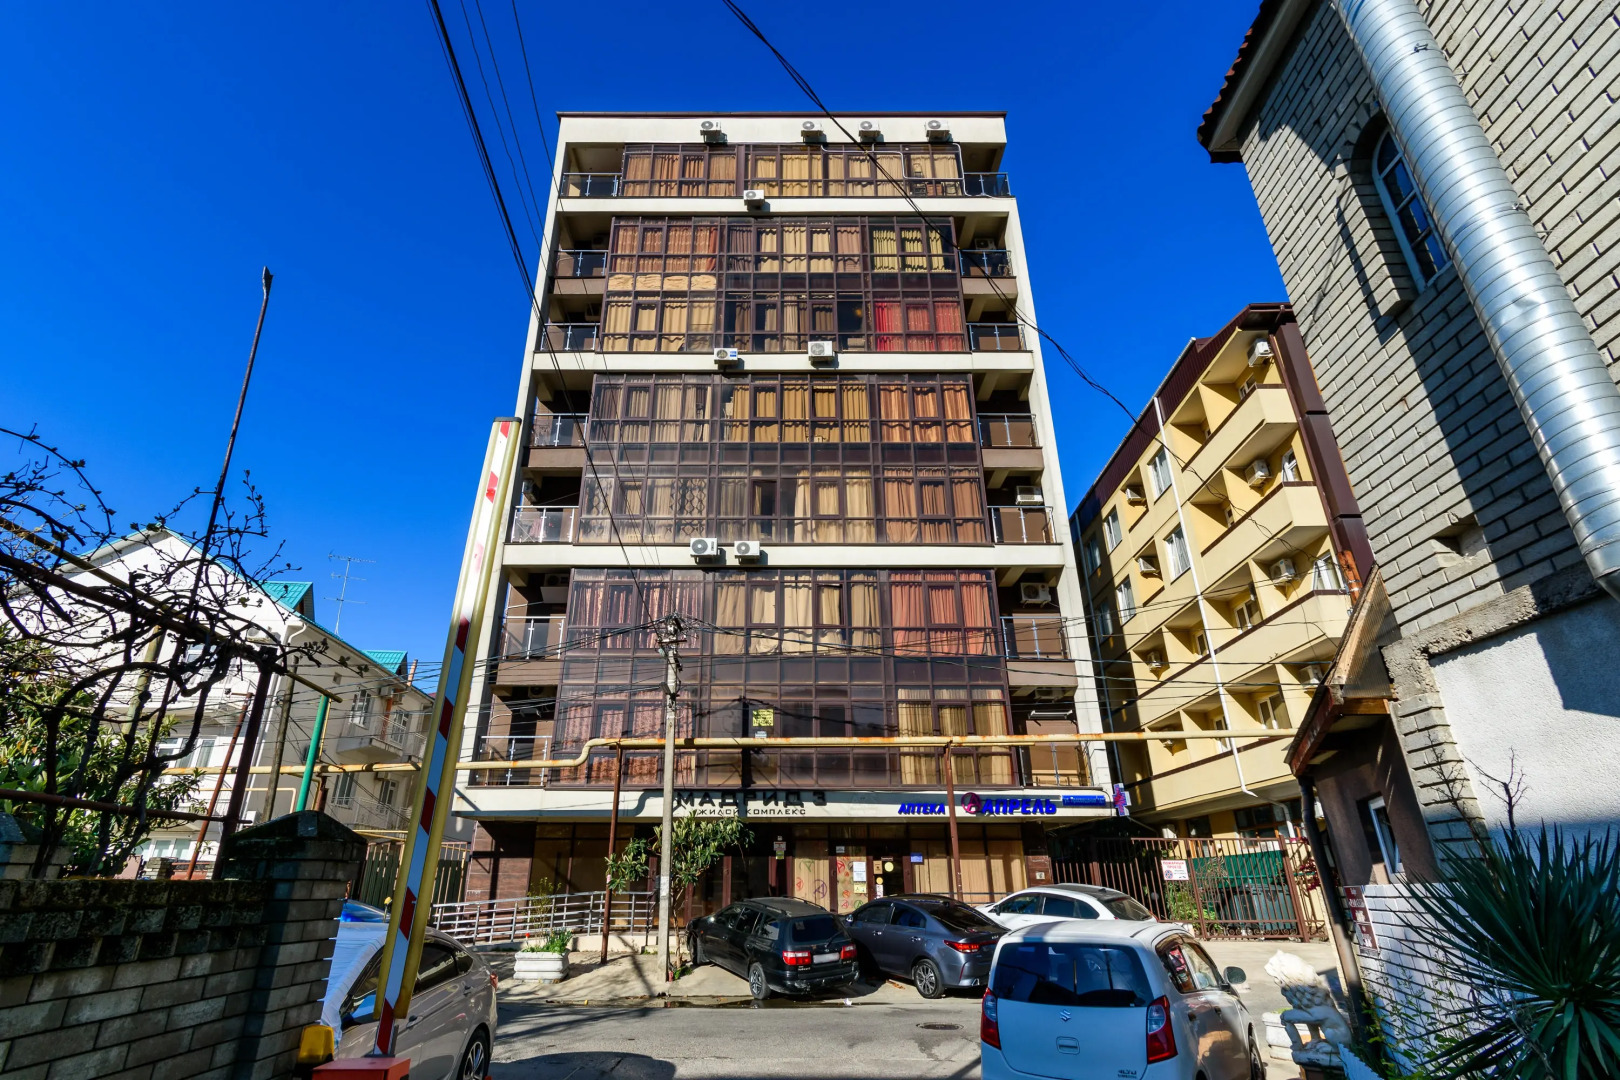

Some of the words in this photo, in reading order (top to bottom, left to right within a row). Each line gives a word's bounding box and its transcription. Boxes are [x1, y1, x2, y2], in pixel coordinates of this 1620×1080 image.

[677, 791, 804, 808] МАДРИД
[813, 791, 828, 807] 3
[898, 803, 946, 815] АПТЕКА
[981, 799, 1057, 815] АПРЕЛЬ
